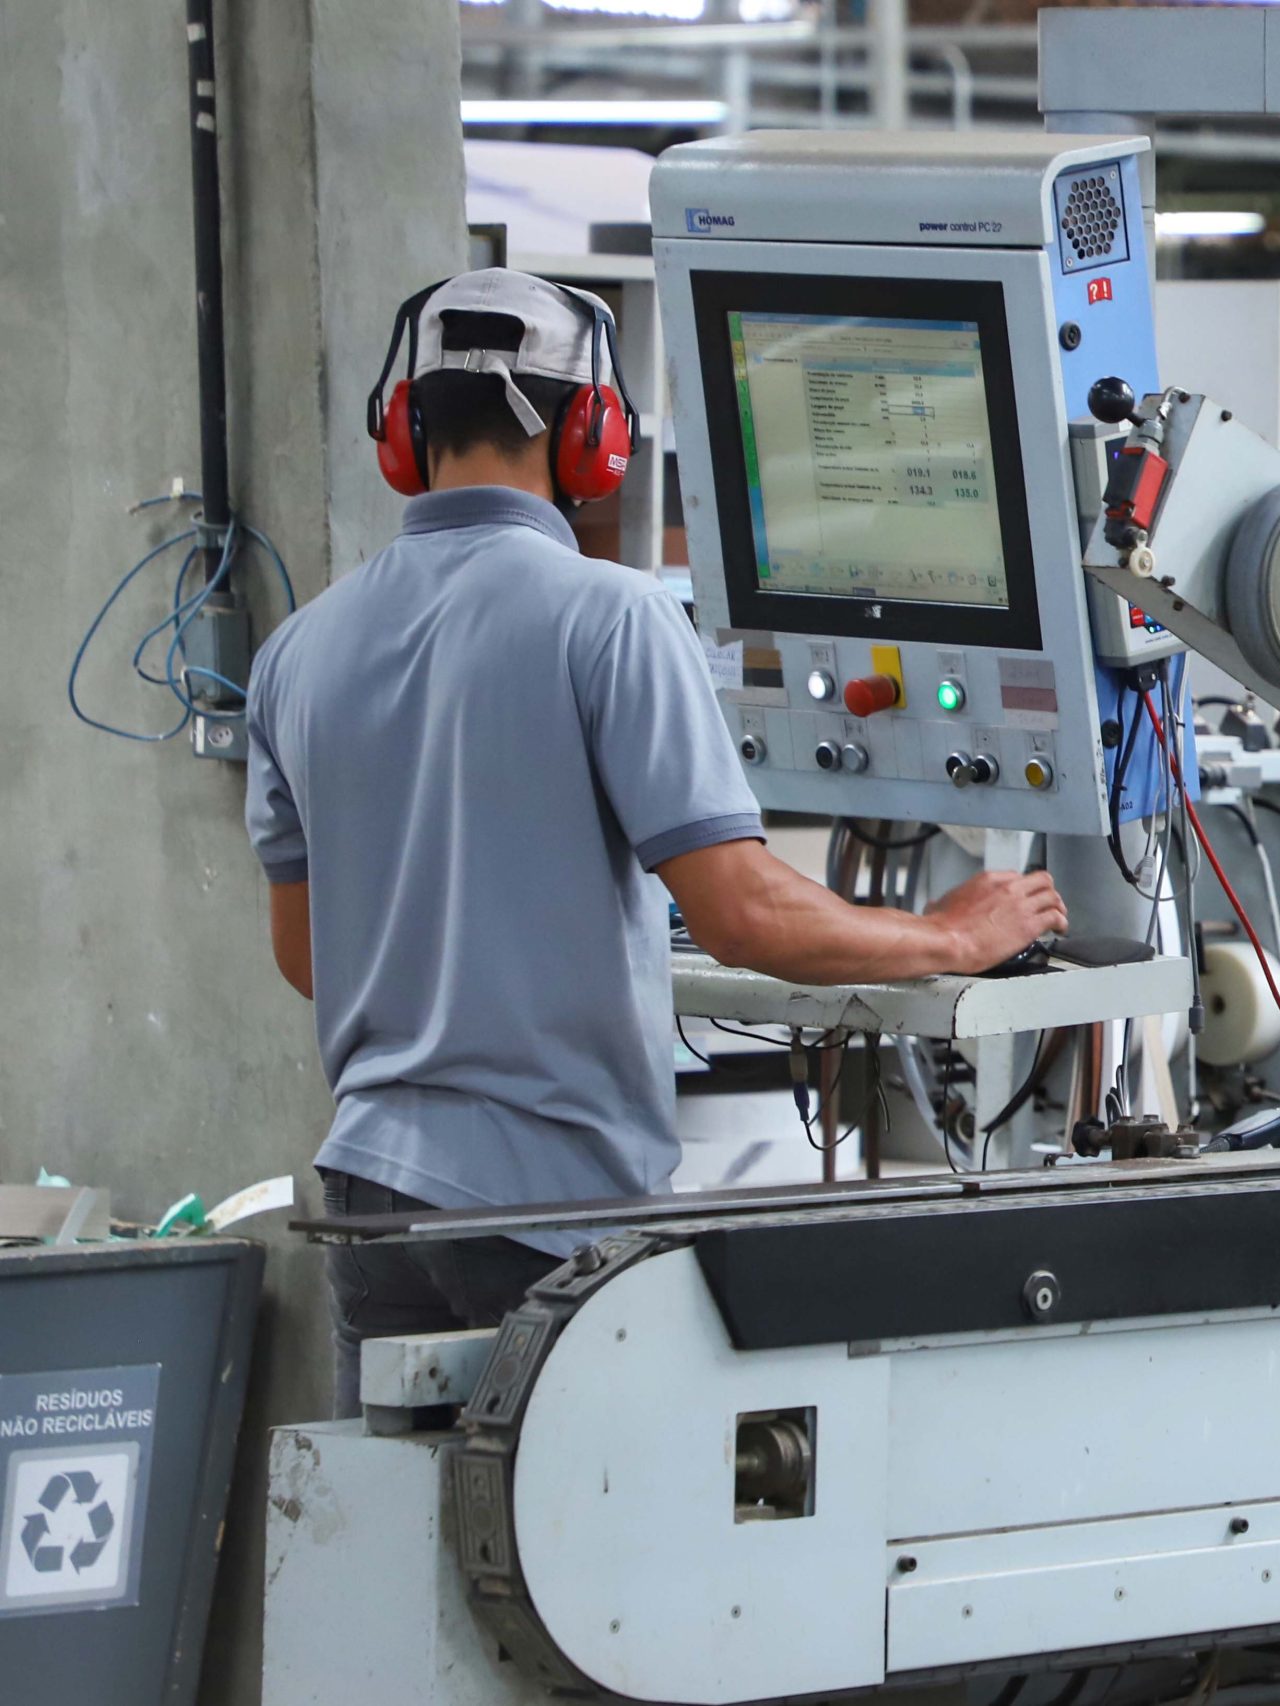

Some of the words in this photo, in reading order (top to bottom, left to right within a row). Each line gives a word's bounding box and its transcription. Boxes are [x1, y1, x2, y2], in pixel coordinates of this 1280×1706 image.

[698, 215, 735, 227] HOMAG
[919, 222, 948, 232] power
[949, 221, 977, 232] control
[978, 221, 991, 233] PC
[36, 1388, 123, 1412] RESÍDUOS
[0, 1415, 38, 1437] NÃO
[43, 1408, 153, 1434] RECICLÁVEIS
